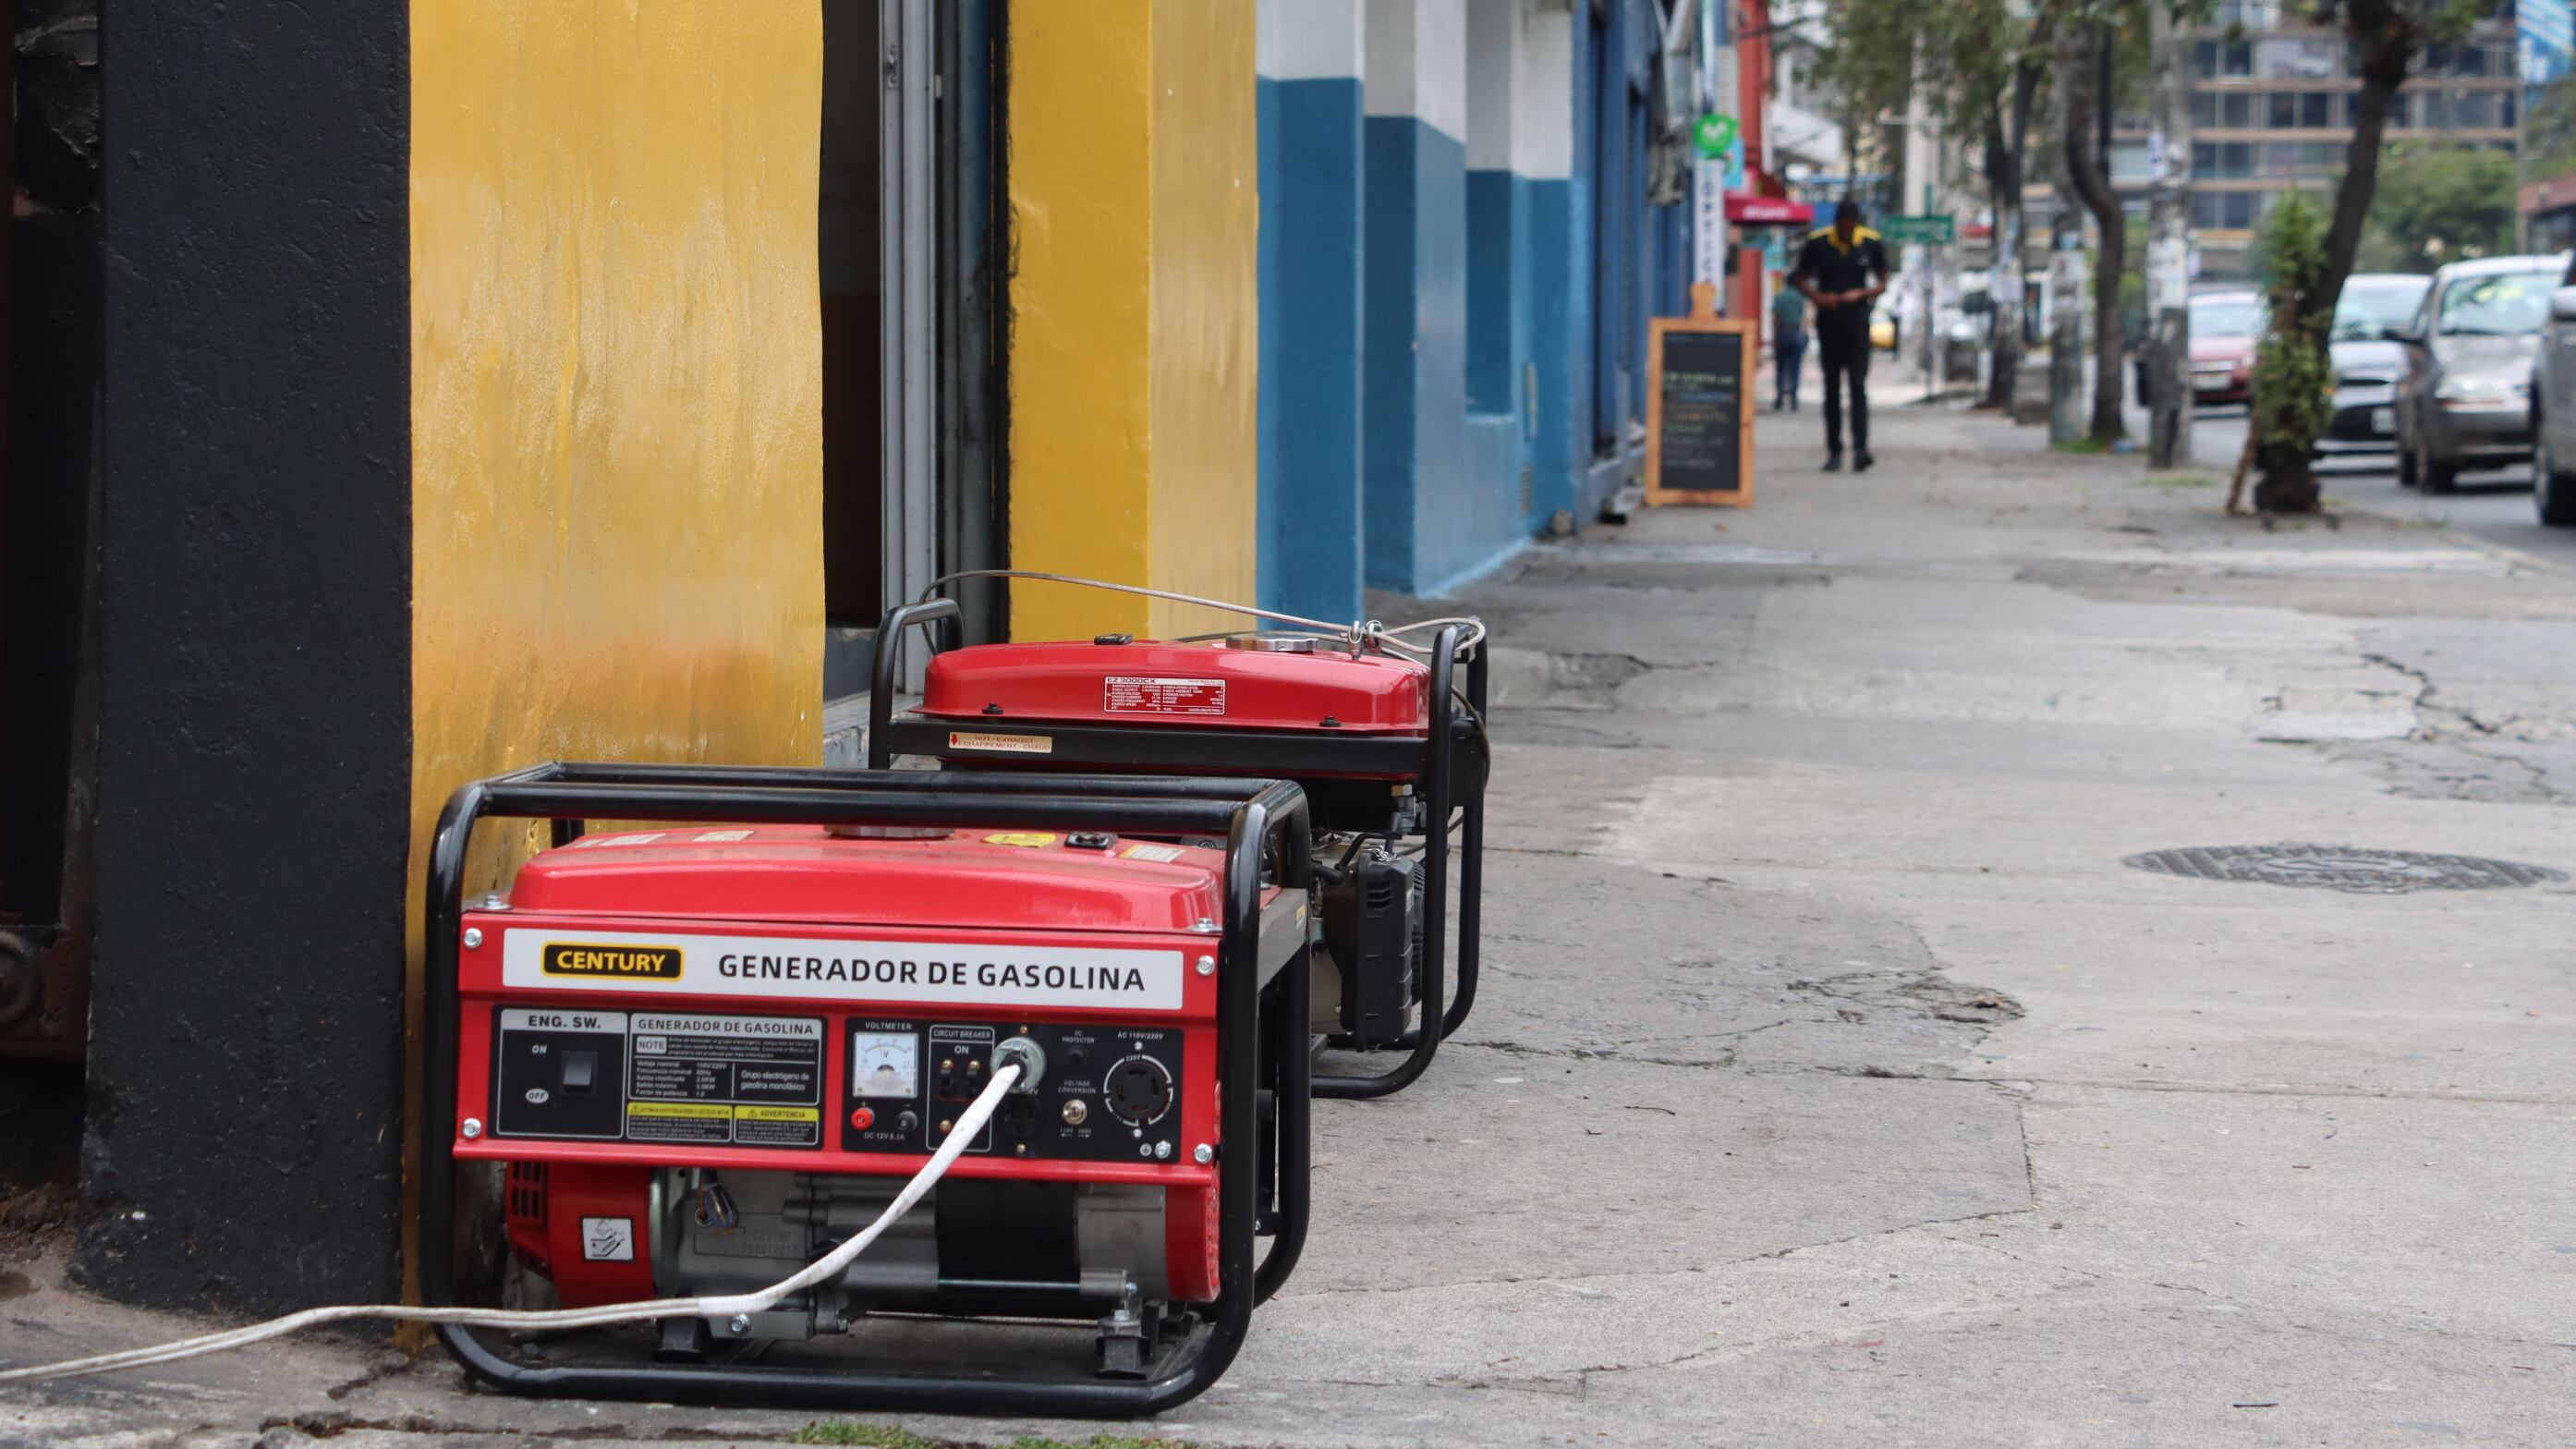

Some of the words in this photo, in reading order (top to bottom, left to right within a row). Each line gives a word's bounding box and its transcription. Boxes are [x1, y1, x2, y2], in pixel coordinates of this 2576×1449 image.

[556, 950, 666, 972] CENTURY
[719, 954, 918, 984] GENERADOR
[928, 962, 967, 985] DE
[977, 963, 1146, 992] GASOLINA
[528, 1015, 567, 1029] ENG.
[572, 1017, 601, 1029] SW.
[638, 1018, 721, 1031] GENERADOR
[724, 1021, 740, 1032] DE
[744, 1022, 813, 1035] GASOLINA
[865, 1022, 912, 1030] VOLTMETER
[933, 1029, 959, 1038] CIRCUIT
[960, 1030, 991, 1040] BREAKER
[1129, 1031, 1164, 1040] 110V/220V
[531, 1044, 548, 1054] ON
[638, 1041, 664, 1050] NOTE
[954, 1045, 969, 1055] ON
[882, 1050, 889, 1058] V
[741, 1069, 761, 1080] Grupo
[762, 1070, 800, 1081] electrógeno
[801, 1072, 809, 1080] de
[741, 1081, 769, 1090] gasolina
[769, 1082, 806, 1091] monofásico
[527, 1091, 547, 1101] OFF
